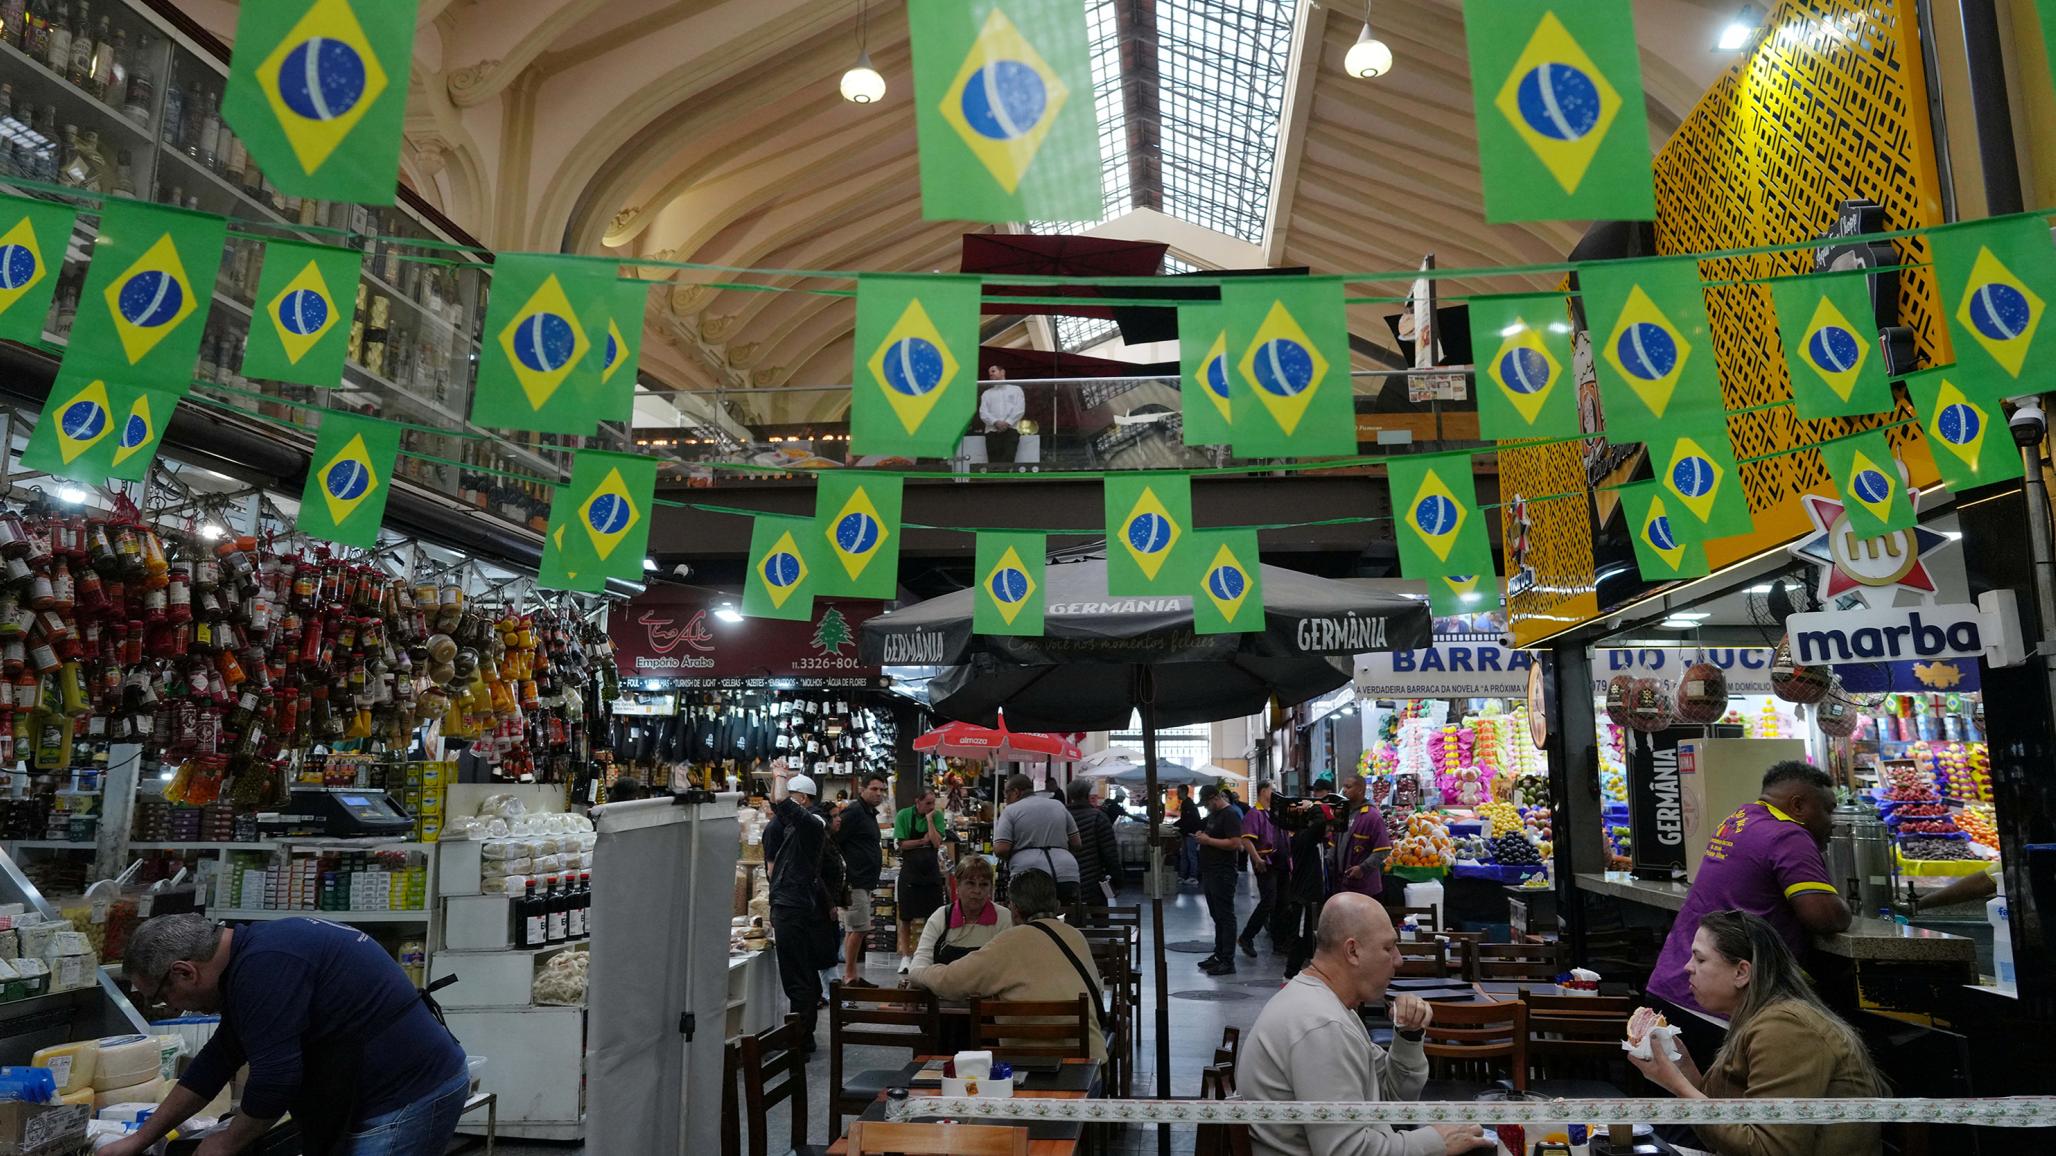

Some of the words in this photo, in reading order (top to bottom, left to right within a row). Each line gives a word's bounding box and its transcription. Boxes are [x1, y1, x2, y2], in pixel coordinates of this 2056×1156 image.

[1049, 598, 1183, 614] GERMÂNIA
[1298, 611, 1387, 651] GERMÂNIA
[1797, 612, 1982, 662] marba
[884, 626, 944, 662] GERMÂNIA
[1074, 640, 1095, 650] nos
[1100, 635, 1165, 649] momentos
[636, 656, 680, 669] Empório
[681, 655, 714, 668] Árabe
[1684, 648, 1773, 670] JUC
[1356, 685, 1362, 694] A
[1363, 685, 1406, 694] VERDADEIRA
[1407, 684, 1440, 694] BARRACA
[1441, 684, 1451, 693] DA
[1452, 684, 1479, 693] NOVELA
[1490, 683, 1521, 693] PRÓXIMA
[960, 737, 988, 745] almaza
[1650, 748, 1682, 845] GERMÂNIA
